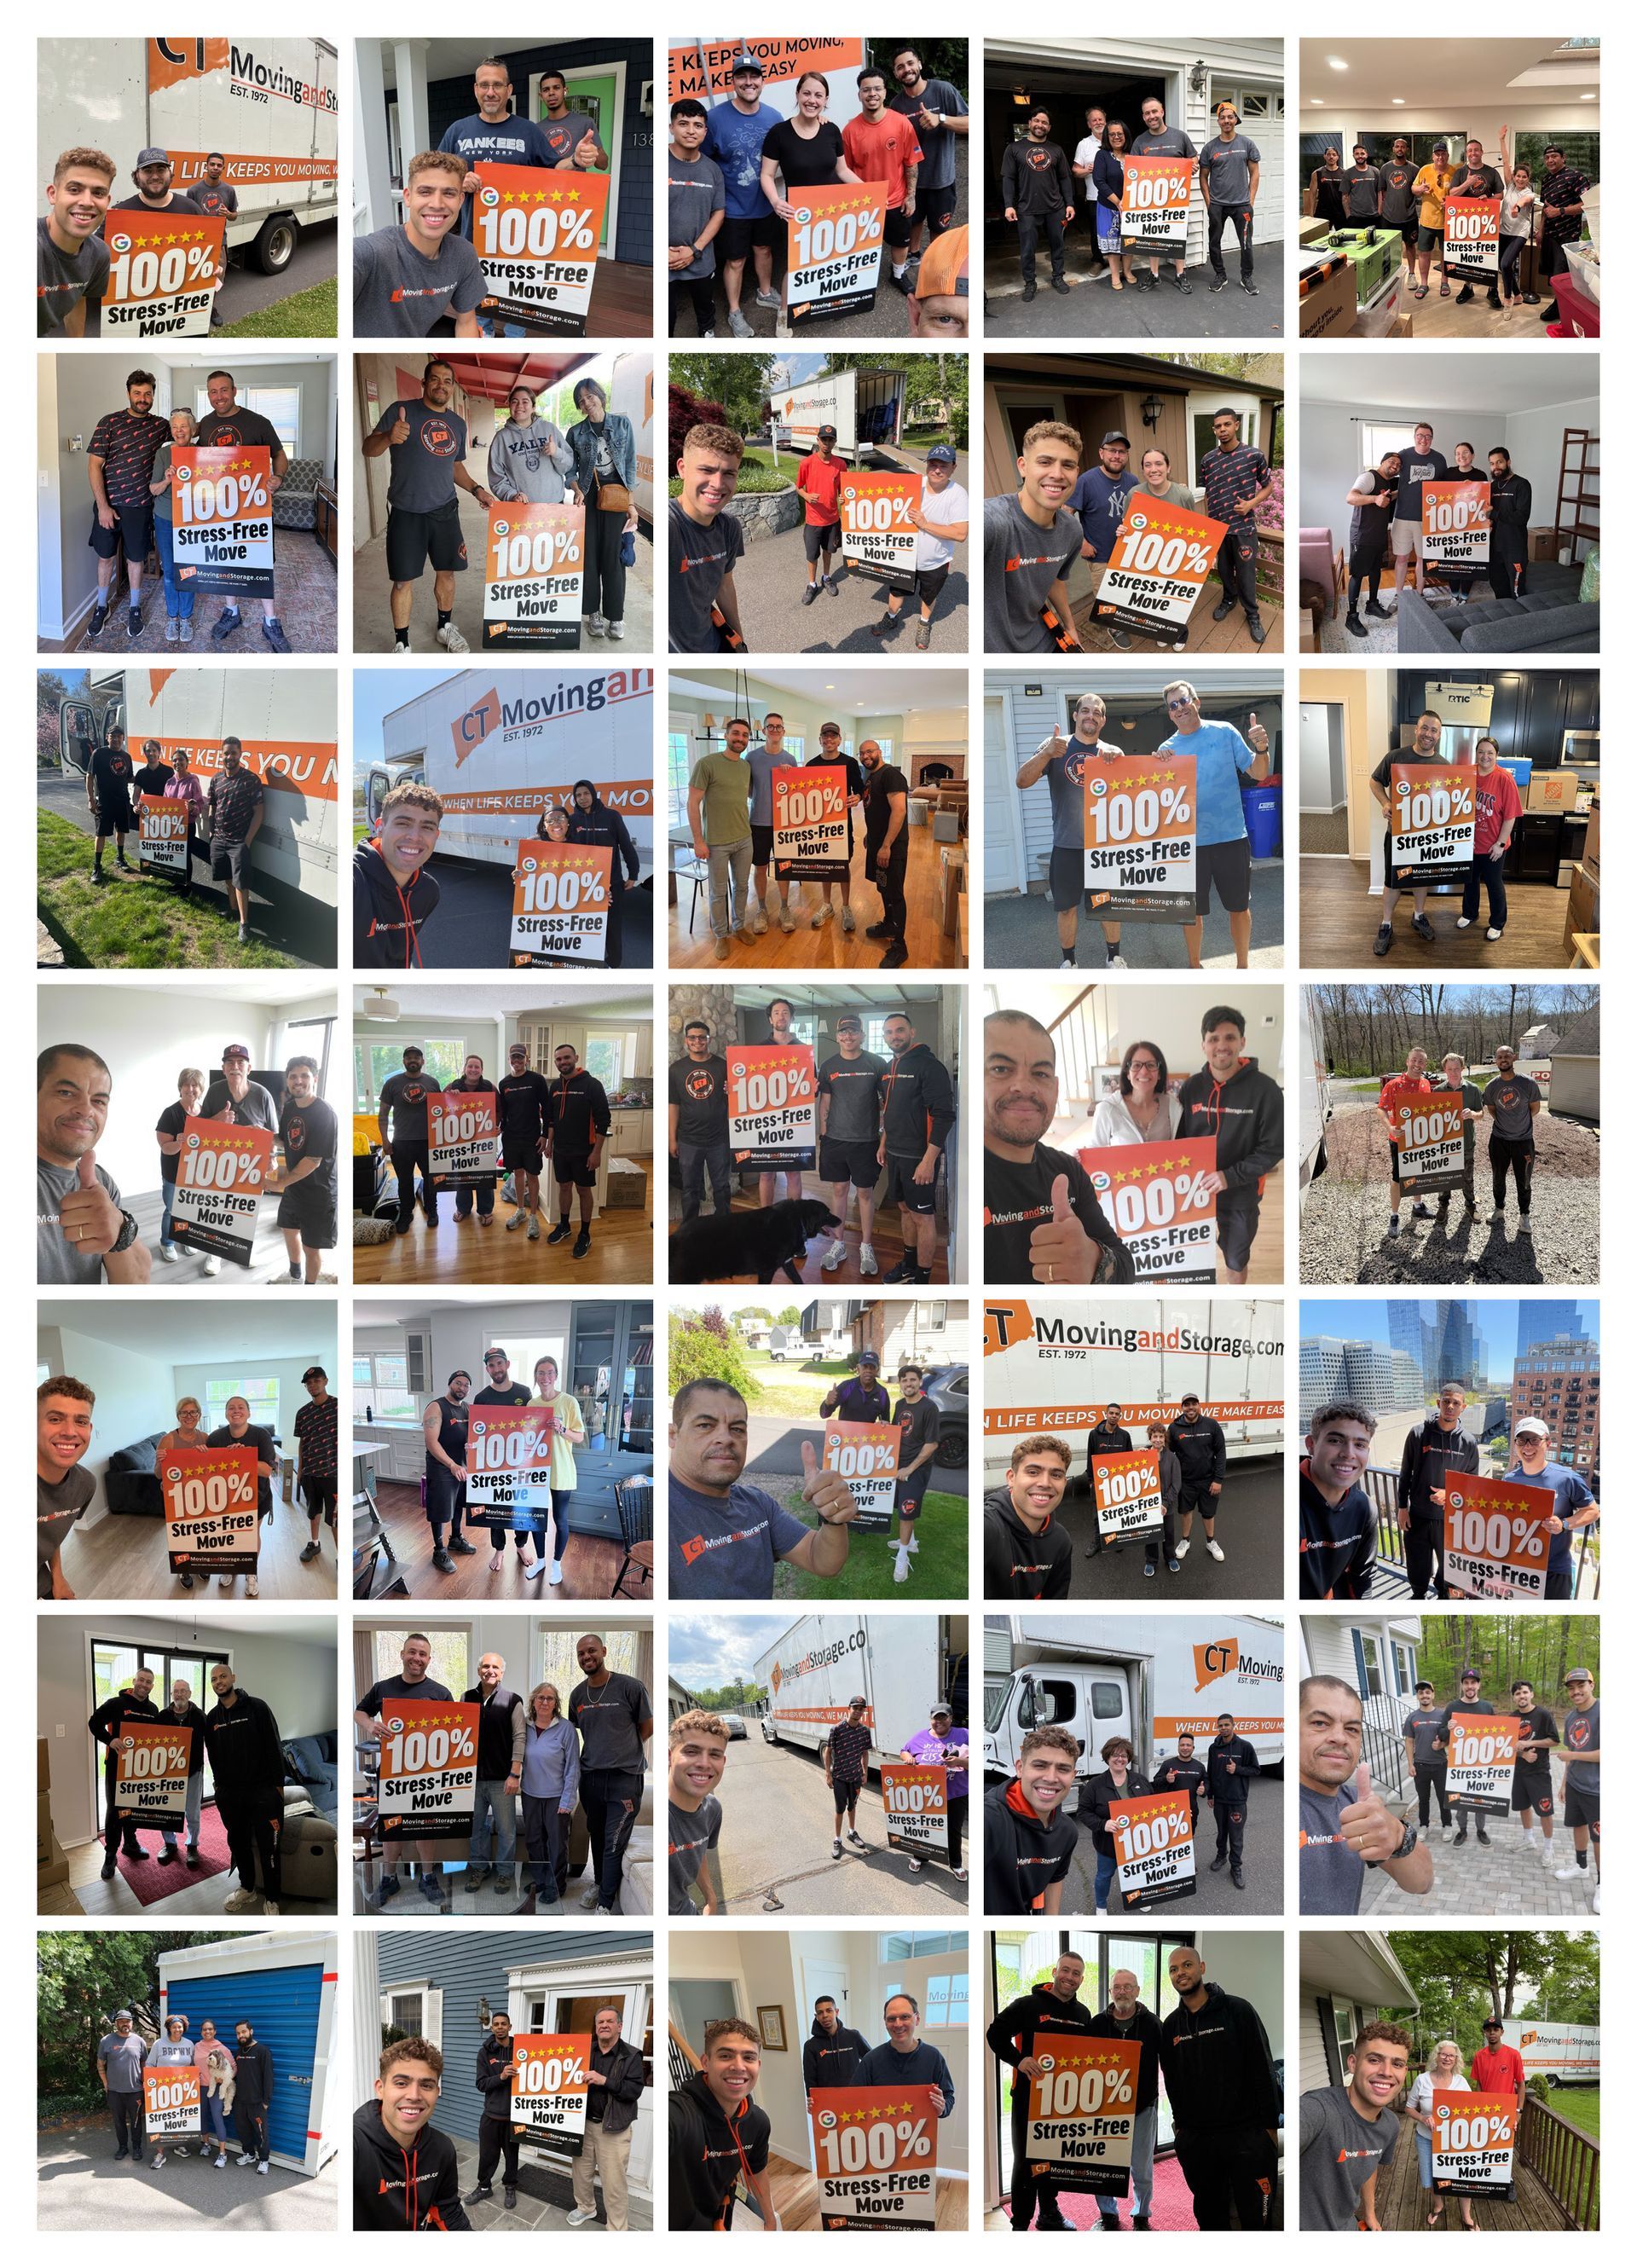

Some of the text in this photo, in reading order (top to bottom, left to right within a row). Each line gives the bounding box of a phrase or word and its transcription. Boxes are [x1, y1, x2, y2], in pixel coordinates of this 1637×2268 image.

[749, 41, 780, 58] YOU
[231, 84, 269, 104] EST. 1972
[458, 136, 525, 153] YANKEES
[226, 161, 270, 178] KEEPS
[274, 163, 296, 177] YOU
[1126, 177, 1187, 208] 100%
[1125, 210, 1185, 223] Stress-Free
[480, 208, 593, 256] 100%
[1446, 242, 1496, 252] Stress-Free
[1461, 253, 1484, 263] Move
[110, 246, 214, 300] 100%
[480, 260, 587, 283] Stress-Free
[794, 251, 877, 287] Stress-Free
[819, 275, 857, 295] Move
[108, 293, 210, 324] Stress-Free
[499, 303, 579, 325] MovingandStorage.com
[177, 473, 267, 522] 100%
[845, 496, 913, 529] 100%
[1426, 500, 1486, 532] 100%
[178, 523, 268, 545] Stress-Free
[846, 534, 914, 547] Stress-Free
[1426, 531, 1487, 547] Stress-Free
[493, 529, 579, 578] 100%
[183, 568, 269, 581] CT MovingandStorage.com
[1108, 571, 1196, 599] Stress-Free
[490, 576, 579, 601] Stress-Free
[517, 599, 558, 617] Move
[1128, 593, 1170, 611] Move
[493, 624, 504, 633] CT
[1115, 610, 1178, 632] MovingandStorage.com
[1449, 695, 1470, 703] RTIC
[461, 706, 489, 742] CT
[503, 725, 543, 743] EST. 1972
[256, 752, 315, 782] YOU
[444, 794, 552, 809] WHEN LIFE KEEPS
[1090, 786, 1190, 842] 100%
[778, 823, 844, 843] Stress-Free
[1397, 826, 1472, 850] Stress-Free
[142, 842, 184, 853] Stress-Free
[153, 851, 174, 862] Move
[797, 842, 829, 857] Move
[1090, 842, 1190, 868] Stress-Free
[1420, 844, 1455, 861] Move
[521, 871, 604, 911] 100%
[1111, 896, 1190, 906] MovingandStorage.com
[518, 916, 603, 933] Stress-Free
[732, 1067, 810, 1113] 100%
[734, 1108, 811, 1132] Stress-Free
[1402, 1109, 1461, 1148] 100%
[432, 1141, 494, 1160] Stress-Free
[1402, 1141, 1461, 1164] Stress-Free
[184, 1150, 261, 1188] 100%
[451, 1156, 480, 1171] Move
[178, 1189, 256, 1212] Stress-Free
[1136, 1250, 1185, 1272] Move
[1038, 1350, 1086, 1359] EST. 1972
[997, 1414, 1036, 1429] LIFE
[1042, 1410, 1096, 1426] KEEPS
[1223, 1406, 1254, 1416] MAKE
[1256, 1405, 1264, 1415] IT
[470, 1430, 547, 1469] 100%
[471, 1471, 547, 1489] Stress-Free
[849, 1480, 892, 1492] ss-Free
[1099, 1466, 1157, 1506] 100%
[1102, 1496, 1159, 1522] Stress-Free
[171, 1514, 253, 1537] Stress-Free
[196, 1534, 234, 1550] Move
[1449, 1553, 1540, 1589] Stress-Free
[1472, 1577, 1514, 1600] Move
[1204, 1646, 1231, 1674] CT
[1176, 1721, 1275, 1733] WHEN KEEPS YOU
[1453, 1736, 1513, 1766] 100%
[121, 1746, 186, 1778] 100%
[385, 1770, 472, 1797] Stress-Free
[1450, 1768, 1511, 1779] Stress-Free
[119, 1779, 184, 1794] Stress-Free
[412, 1791, 453, 1810] Move
[887, 1785, 943, 1812] 100%
[888, 1814, 944, 1827] Stress-Free
[1122, 1845, 1190, 1877] Stress-Free
[1145, 1866, 1177, 1884] Move
[1521, 2034, 1533, 2045] CT
[518, 2057, 583, 2092] 100%
[1036, 2068, 1132, 2115] 100%
[514, 2096, 583, 2109] Stress-Free
[148, 2106, 199, 2123] Stress-Free
[165, 2120, 188, 2130] Move
[1033, 2119, 1130, 2139] Stress-Free
[1437, 2151, 1509, 2166] Stress-Free
[1458, 2167, 1491, 2178] Move
[825, 2174, 930, 2197] Stress-Free
[856, 2196, 904, 2213] Move
